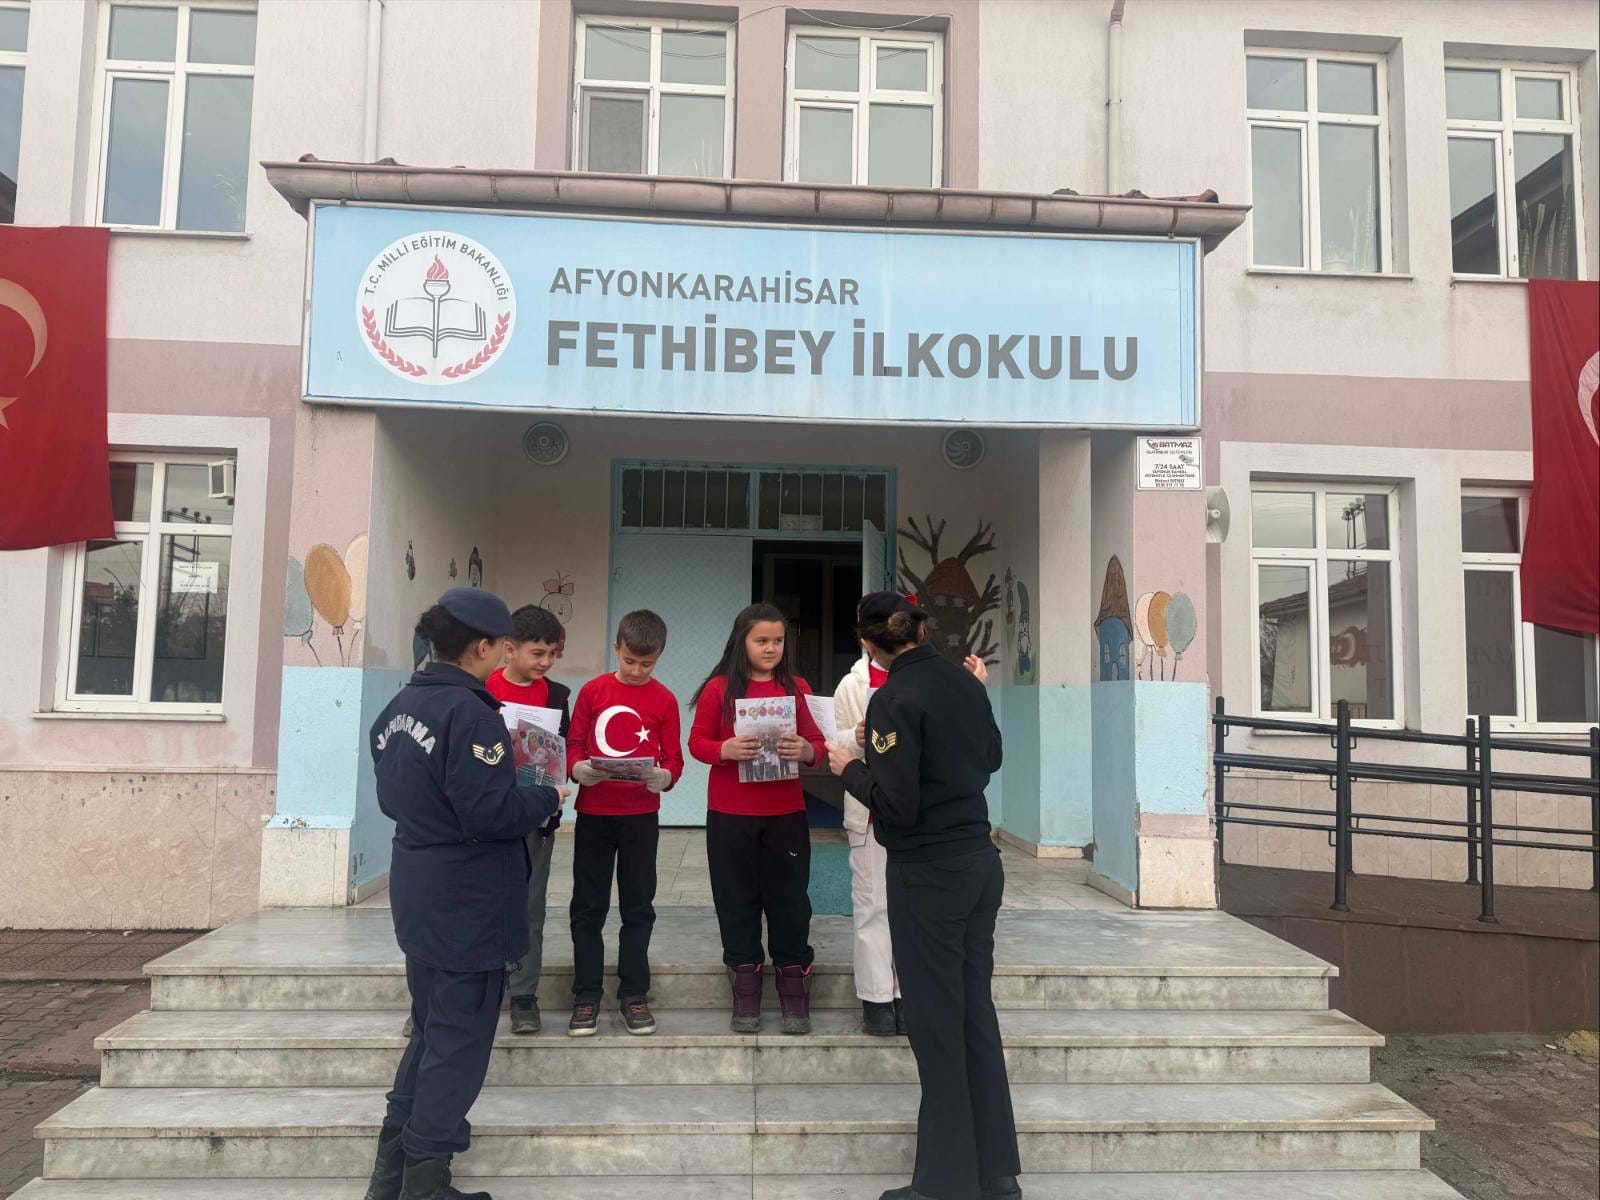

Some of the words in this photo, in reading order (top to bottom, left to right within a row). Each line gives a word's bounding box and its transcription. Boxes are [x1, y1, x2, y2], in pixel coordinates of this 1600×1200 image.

[364, 274, 382, 294] T.C.
[377, 241, 409, 272] MİLLİ
[411, 235, 457, 251] EĞİTİM
[460, 243, 509, 300] BAKANLIĞI
[549, 267, 859, 306] AFYONKARAHİSAR
[547, 313, 836, 376] FETHİBEY
[852, 318, 1138, 381] İLKOKULU
